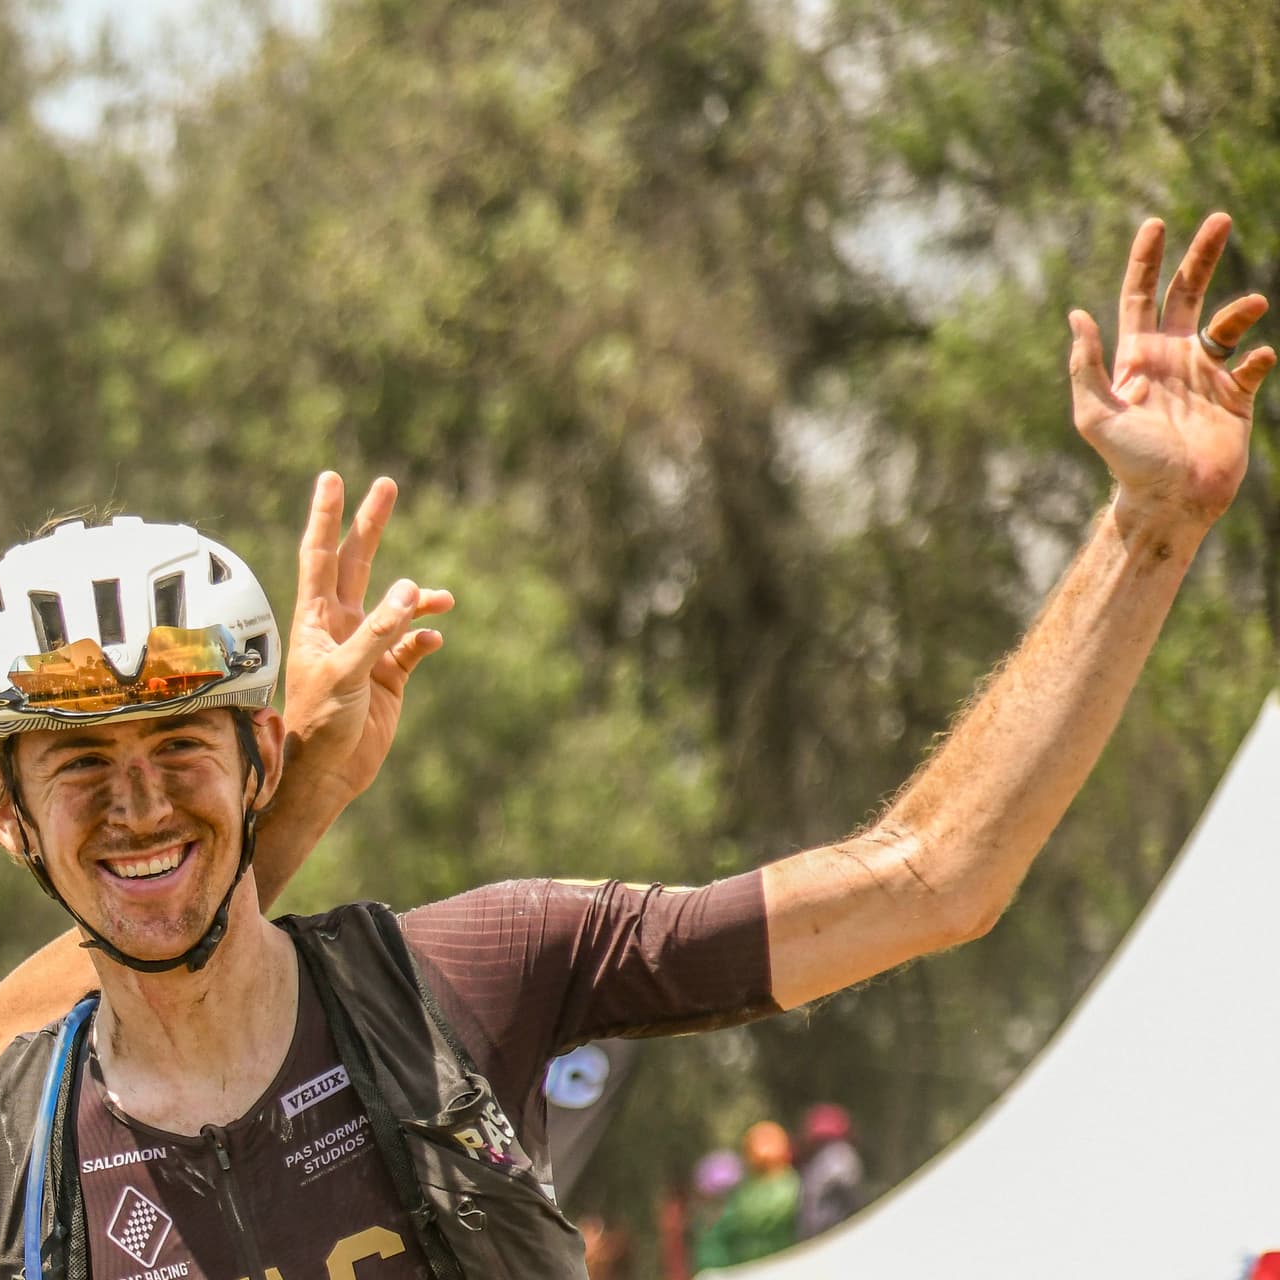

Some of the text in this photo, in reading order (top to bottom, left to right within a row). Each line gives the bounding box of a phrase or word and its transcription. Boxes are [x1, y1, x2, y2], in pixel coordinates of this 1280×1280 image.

[288, 1070, 345, 1110] VELUX
[82, 1146, 168, 1174] SALOMON
[285, 1145, 313, 1168] PAS
[315, 1114, 370, 1148] NORMA
[303, 1132, 366, 1175] STUDIOS
